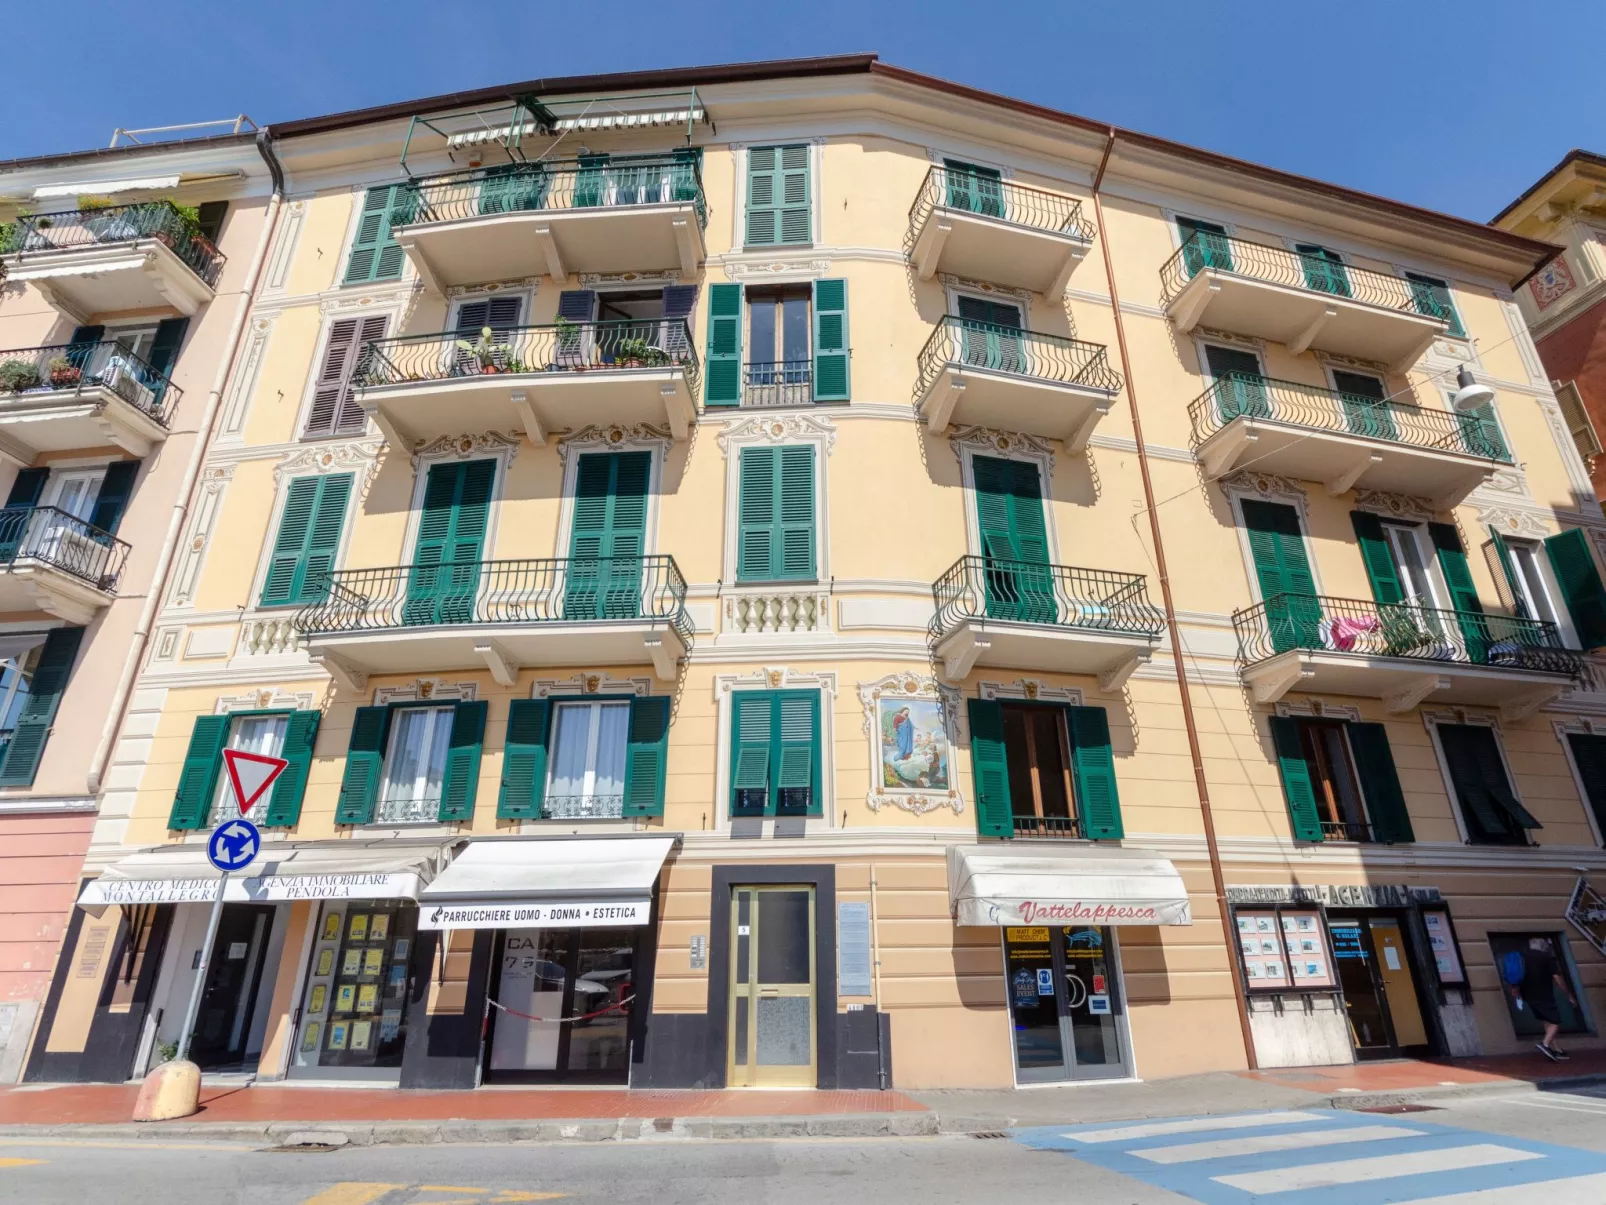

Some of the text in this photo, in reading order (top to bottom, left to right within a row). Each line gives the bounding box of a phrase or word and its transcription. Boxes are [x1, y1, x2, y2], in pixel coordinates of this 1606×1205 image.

[109, 879, 164, 892] CENTRO
[254, 874, 389, 888] AGENZIA IMMOBILIARE
[286, 886, 350, 898] PENDOLA
[443, 907, 636, 922] PARRUCCHIERE UOMO DONNA ESTETICA
[1018, 901, 1157, 924] Vattelappesca
[507, 937, 535, 950] CA
